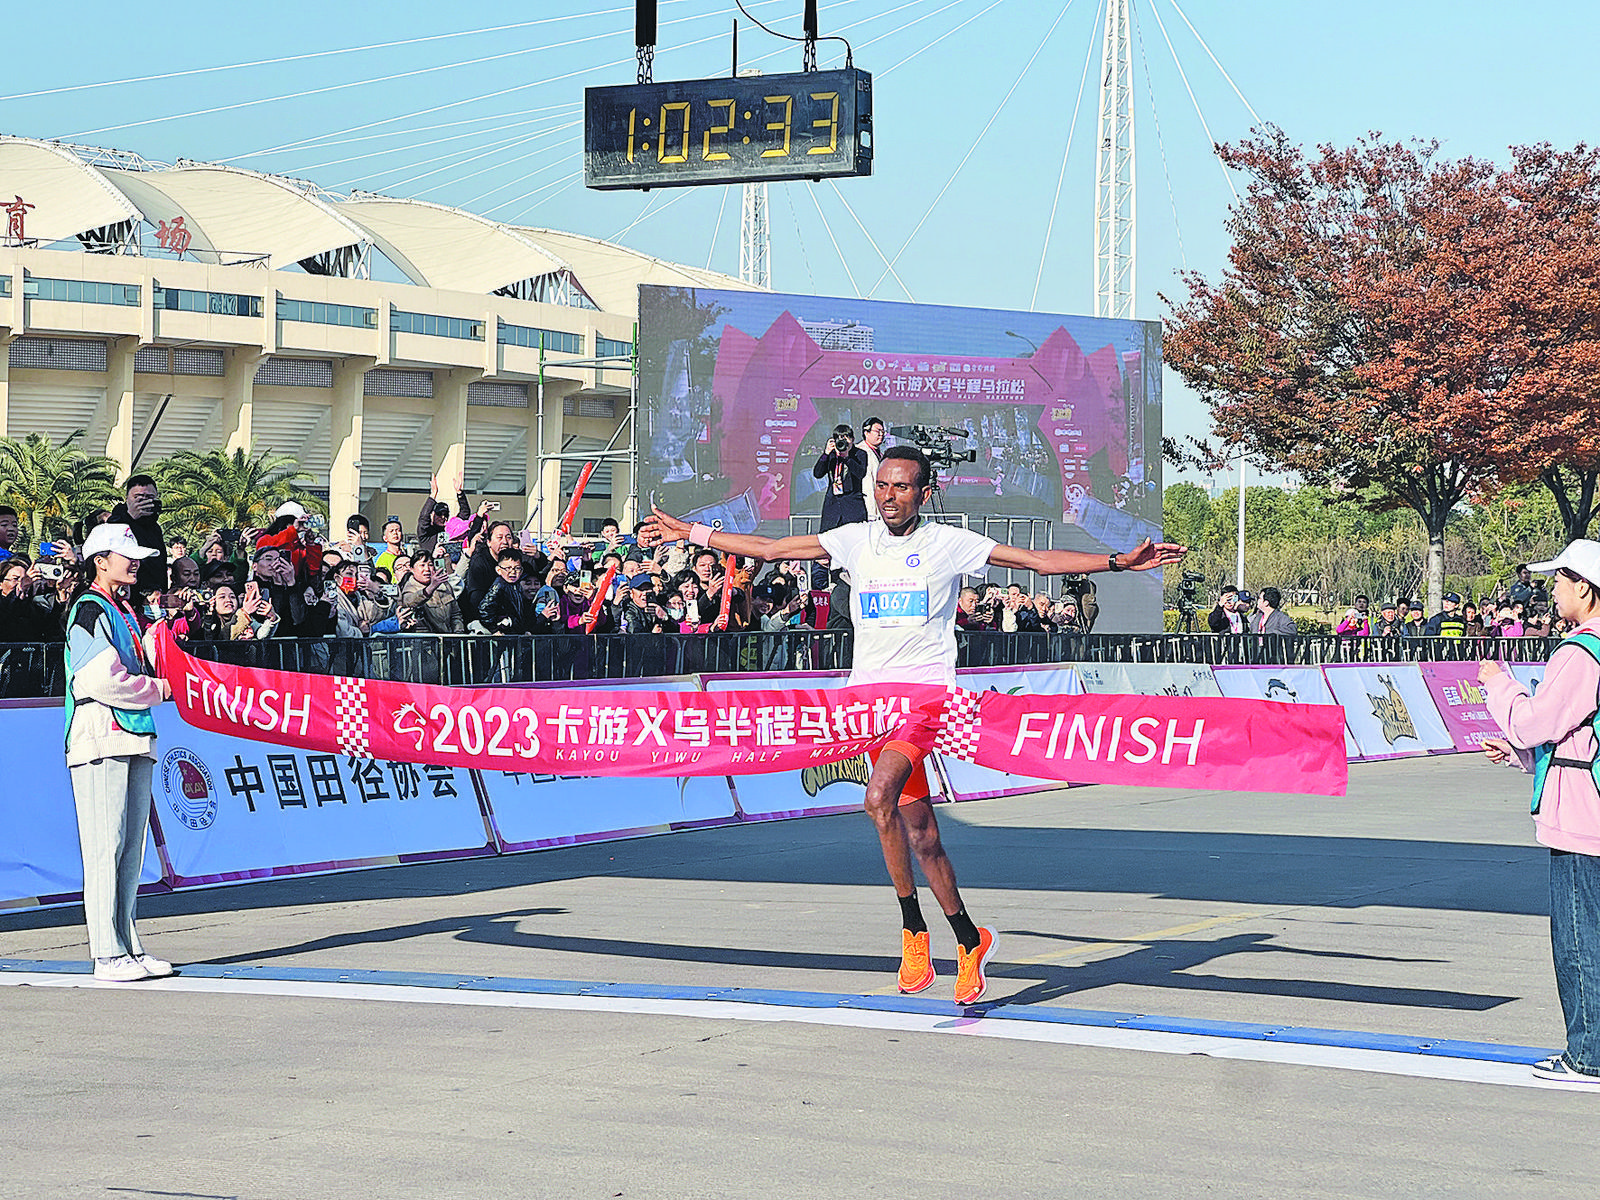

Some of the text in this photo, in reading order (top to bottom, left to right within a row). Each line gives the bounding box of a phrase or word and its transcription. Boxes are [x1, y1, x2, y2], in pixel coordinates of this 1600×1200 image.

[626, 91, 839, 164] 1:02:33
[869, 593, 911, 614] A067
[185, 672, 311, 736] FINISH
[556, 749, 620, 762] KAYOU
[651, 751, 702, 763] YIWU
[731, 751, 782, 763] HALF
[1010, 712, 1205, 766] FINISH
[224, 754, 458, 812] 中国田径协会
